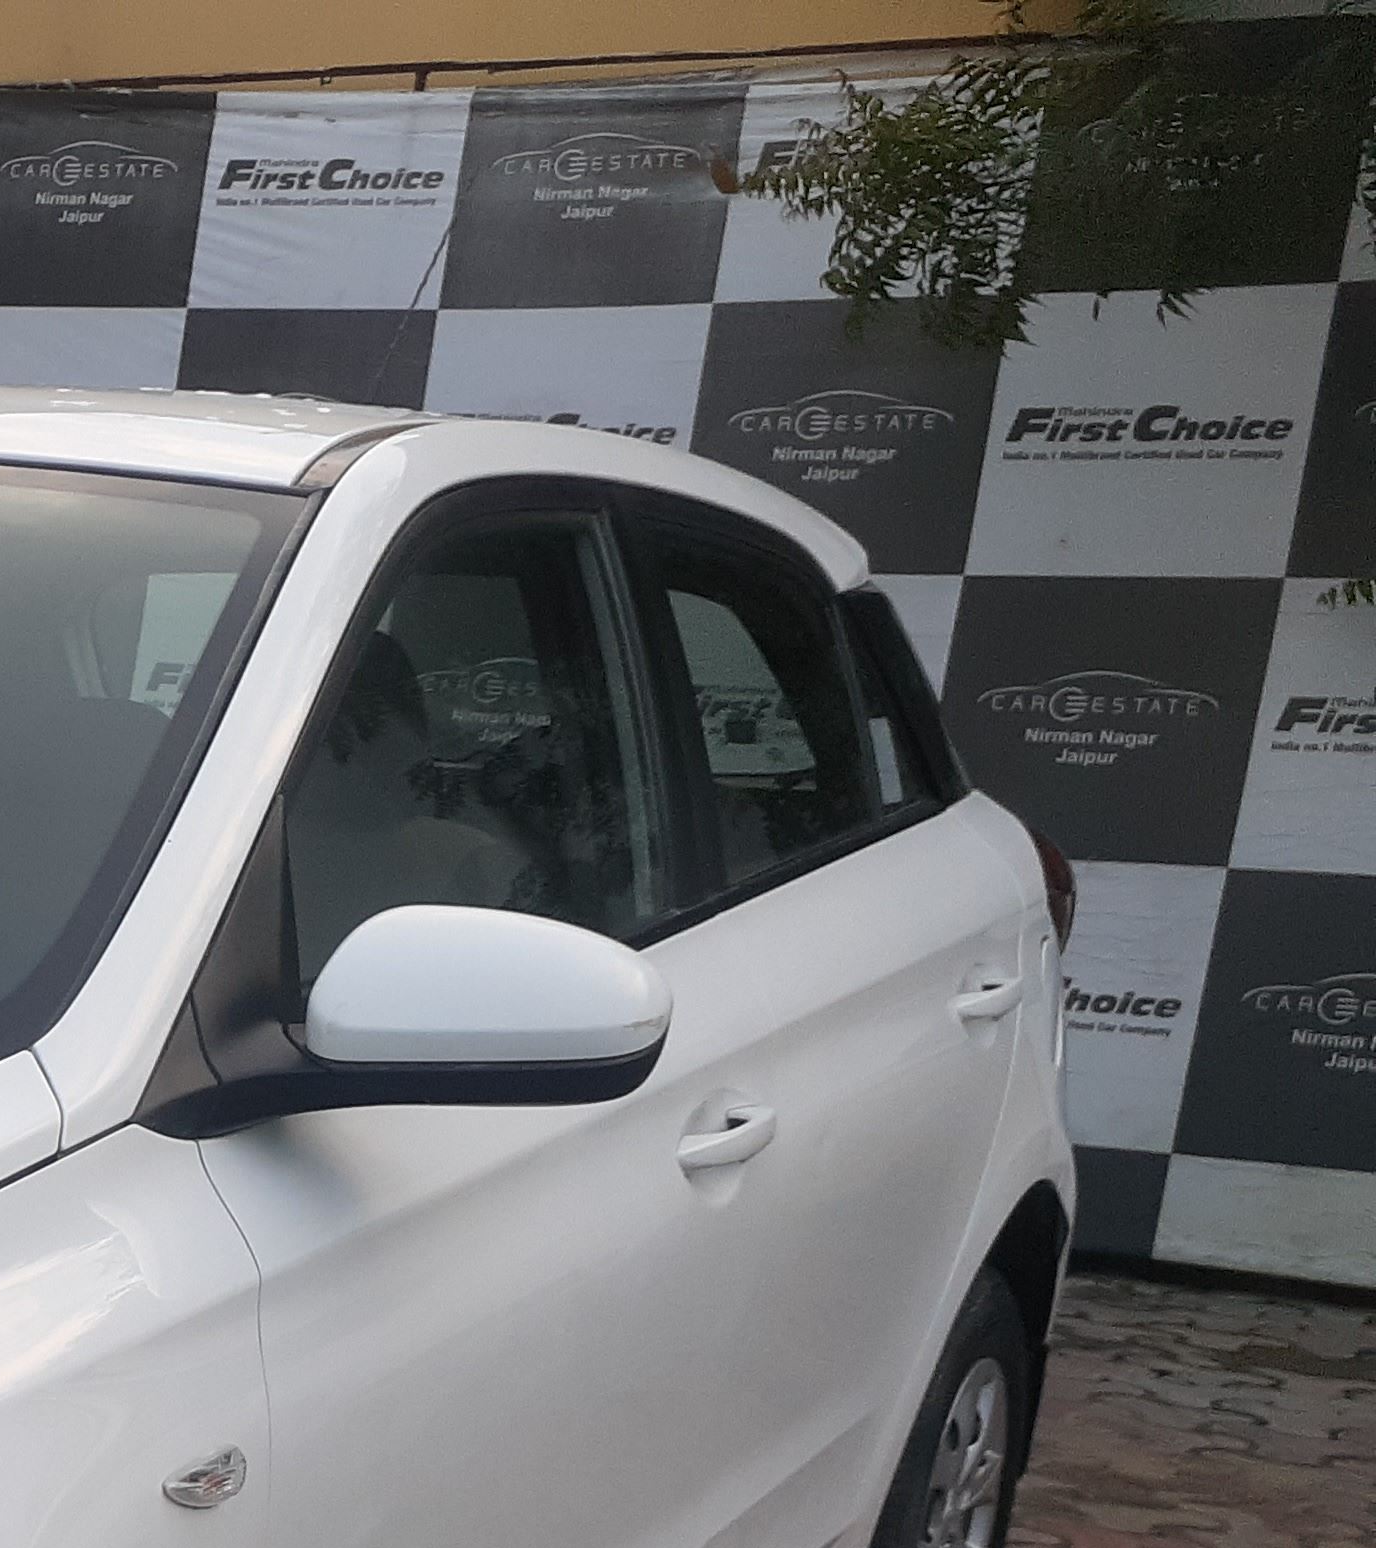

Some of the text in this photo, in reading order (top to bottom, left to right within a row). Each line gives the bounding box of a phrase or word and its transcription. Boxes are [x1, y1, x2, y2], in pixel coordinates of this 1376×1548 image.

[218, 159, 445, 191] First Choice
[35, 192, 134, 208] Nirman Nagar
[533, 185, 649, 201] Nirman Nagar
[58, 210, 105, 225] Jaipur
[560, 206, 614, 220] Jaipur
[1005, 405, 1294, 442] First Choice
[772, 447, 897, 465] Nirman Nagar
[801, 466, 860, 482] Jaipur
[1274, 696, 1376, 734] Firs
[1024, 728, 1160, 749] Nirman Nagar
[1055, 748, 1119, 766] Jaipur
[1063, 975, 1183, 1018] hoice
[1291, 1028, 1365, 1049] Nirman
